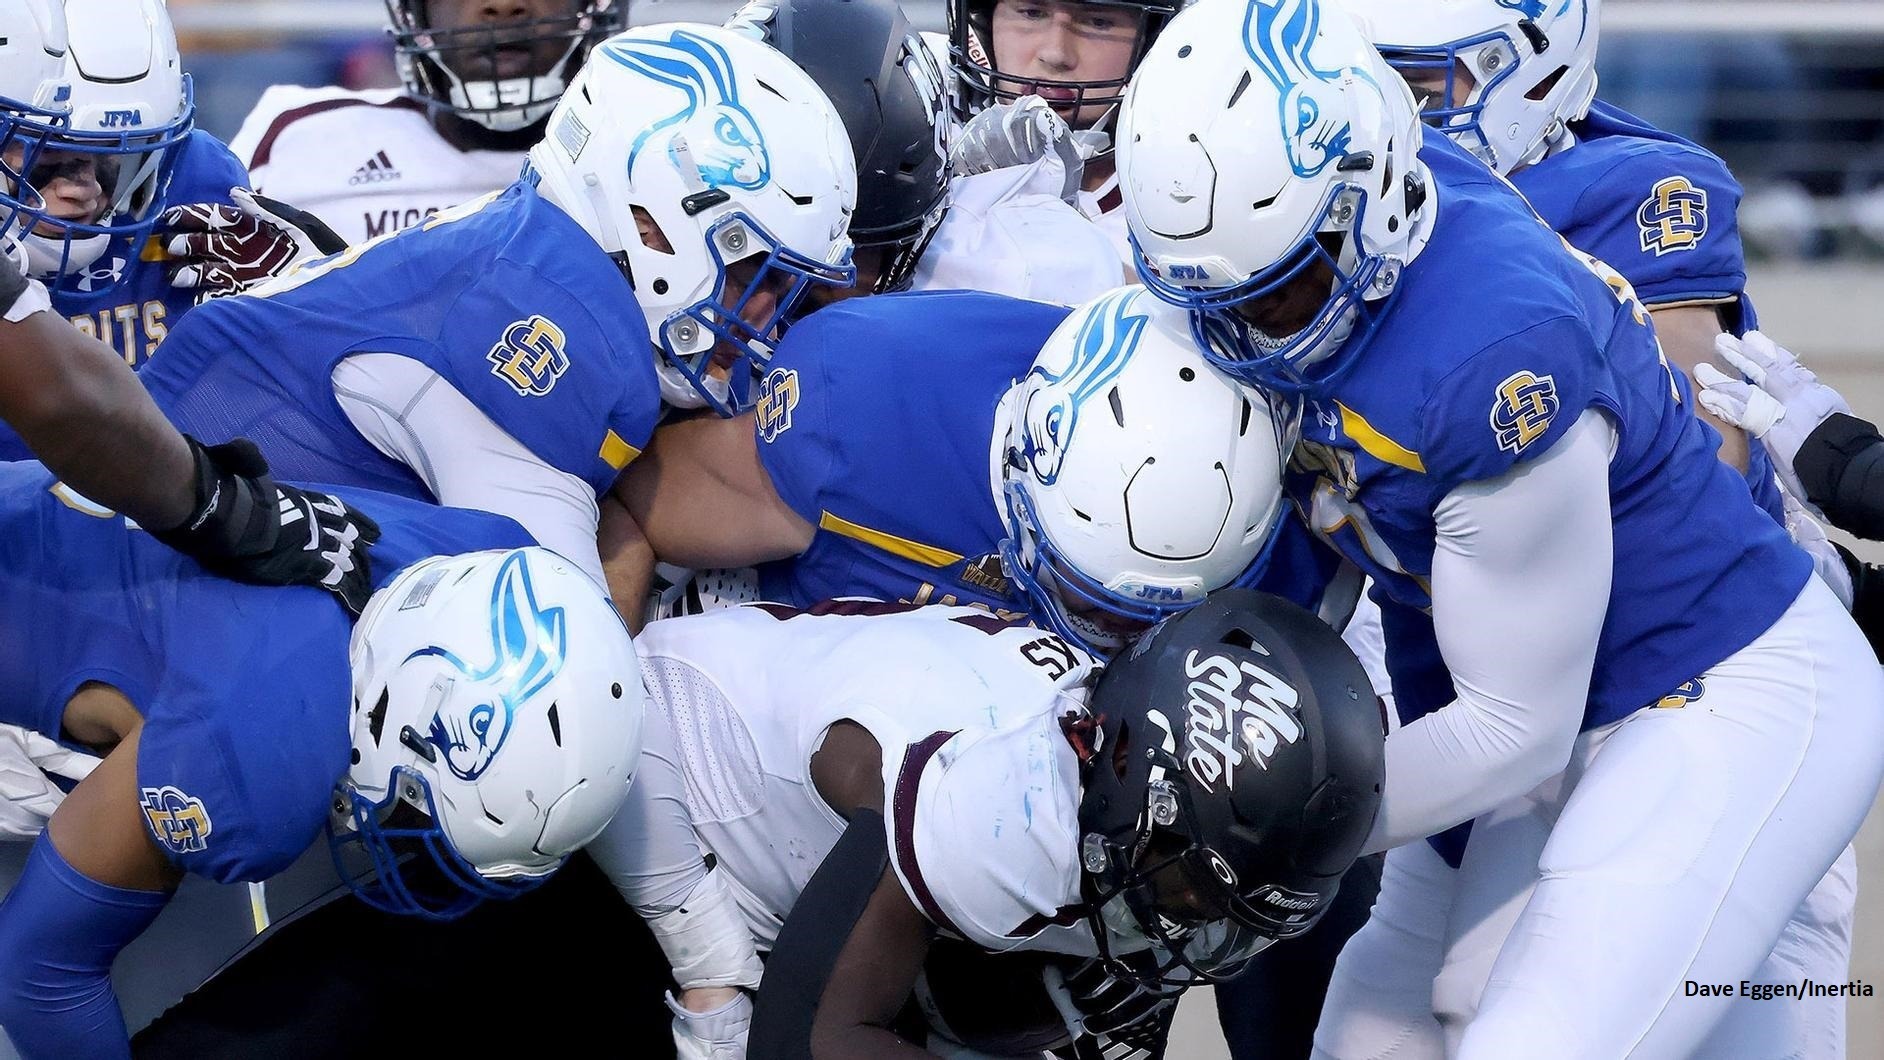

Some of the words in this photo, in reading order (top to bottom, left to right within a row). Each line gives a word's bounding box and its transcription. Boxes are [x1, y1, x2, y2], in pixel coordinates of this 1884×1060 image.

[99, 109, 142, 127] JFPA
[1135, 584, 1185, 601] JFPA
[1184, 649, 1244, 795] State
